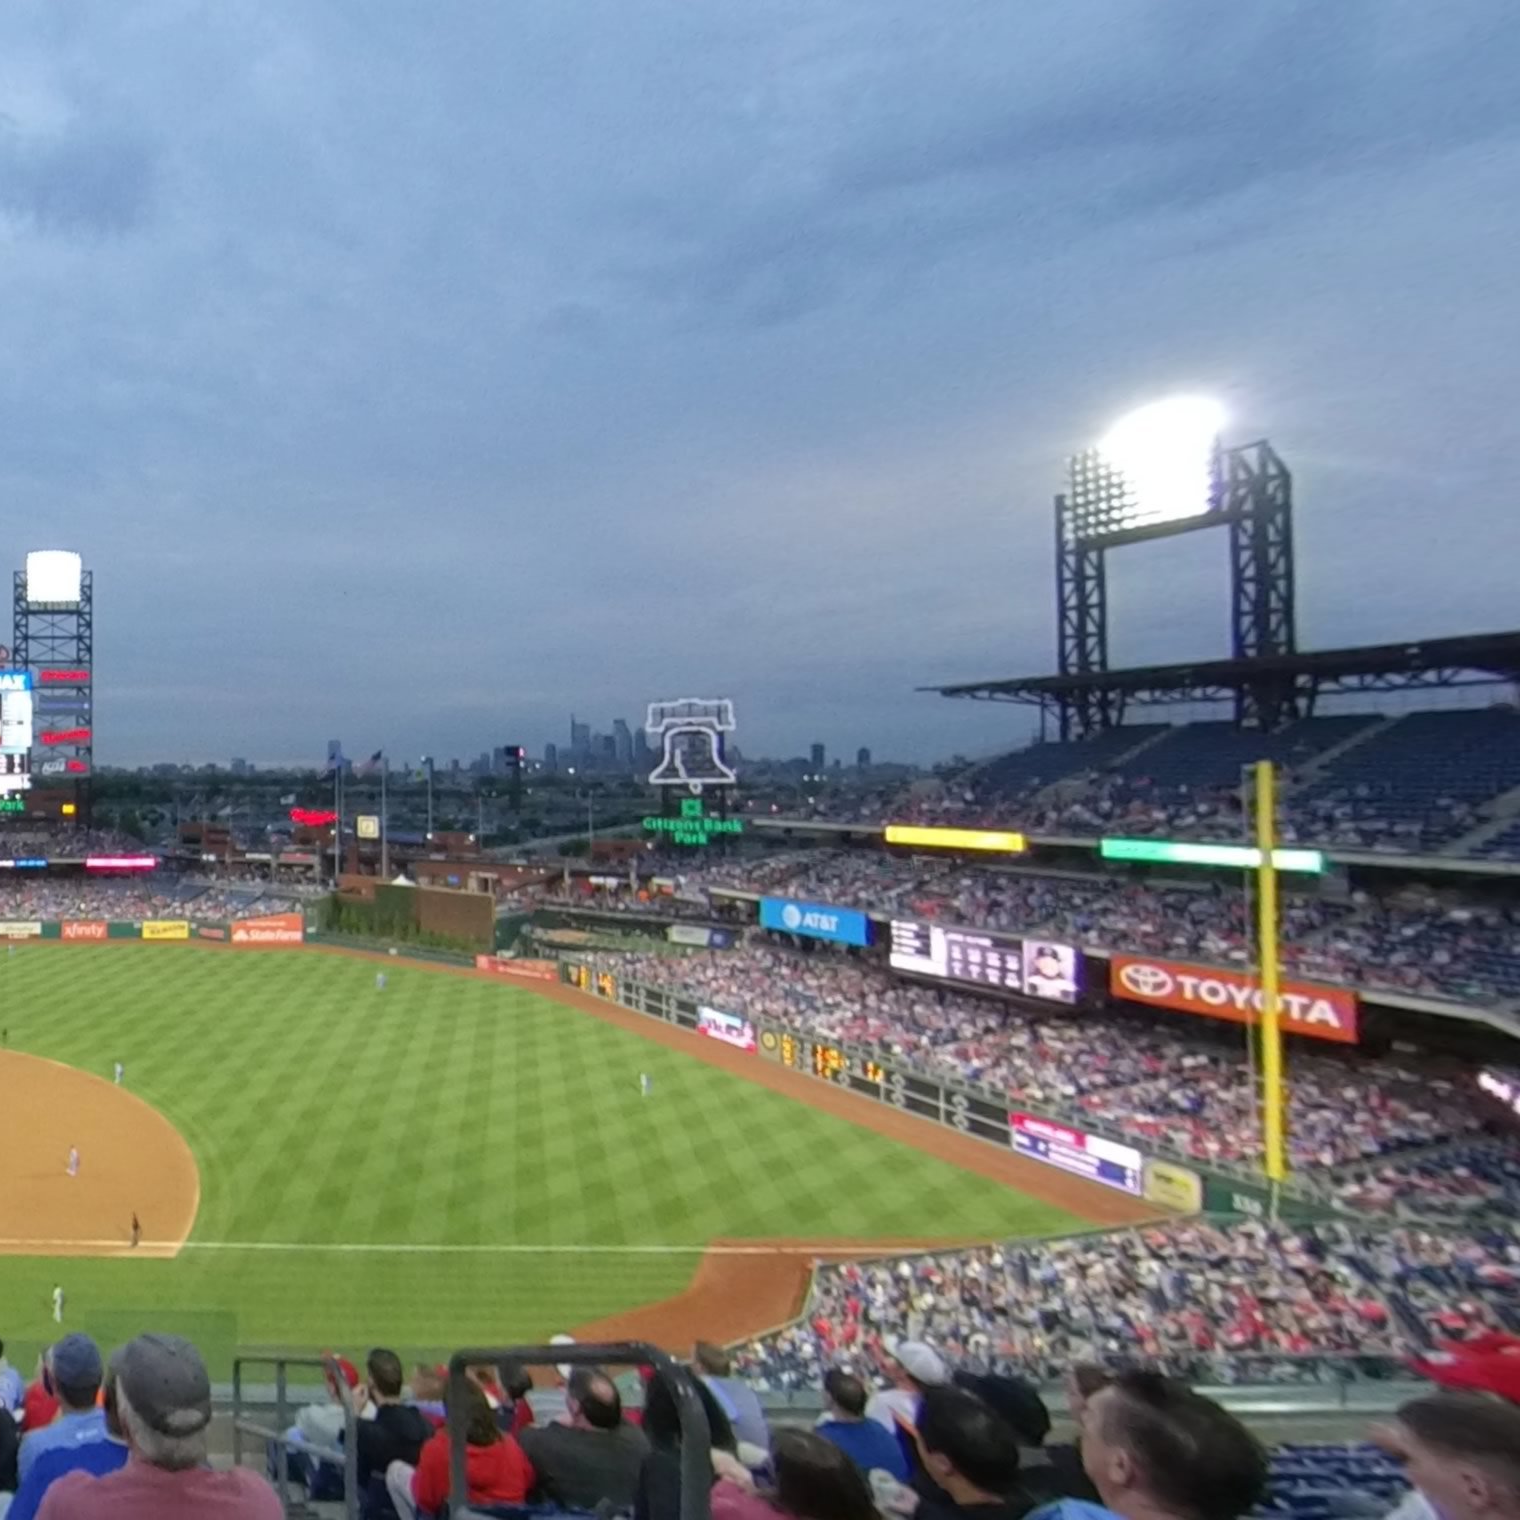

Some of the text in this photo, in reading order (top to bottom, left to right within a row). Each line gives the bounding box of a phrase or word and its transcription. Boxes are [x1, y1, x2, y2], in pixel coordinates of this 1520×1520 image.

[643, 817, 742, 833] Citizens Bank
[674, 831, 708, 845] Park
[802, 911, 839, 933] AT&T
[64, 925, 105, 940] xfinity
[1176, 974, 1342, 1029] TOYOTA
